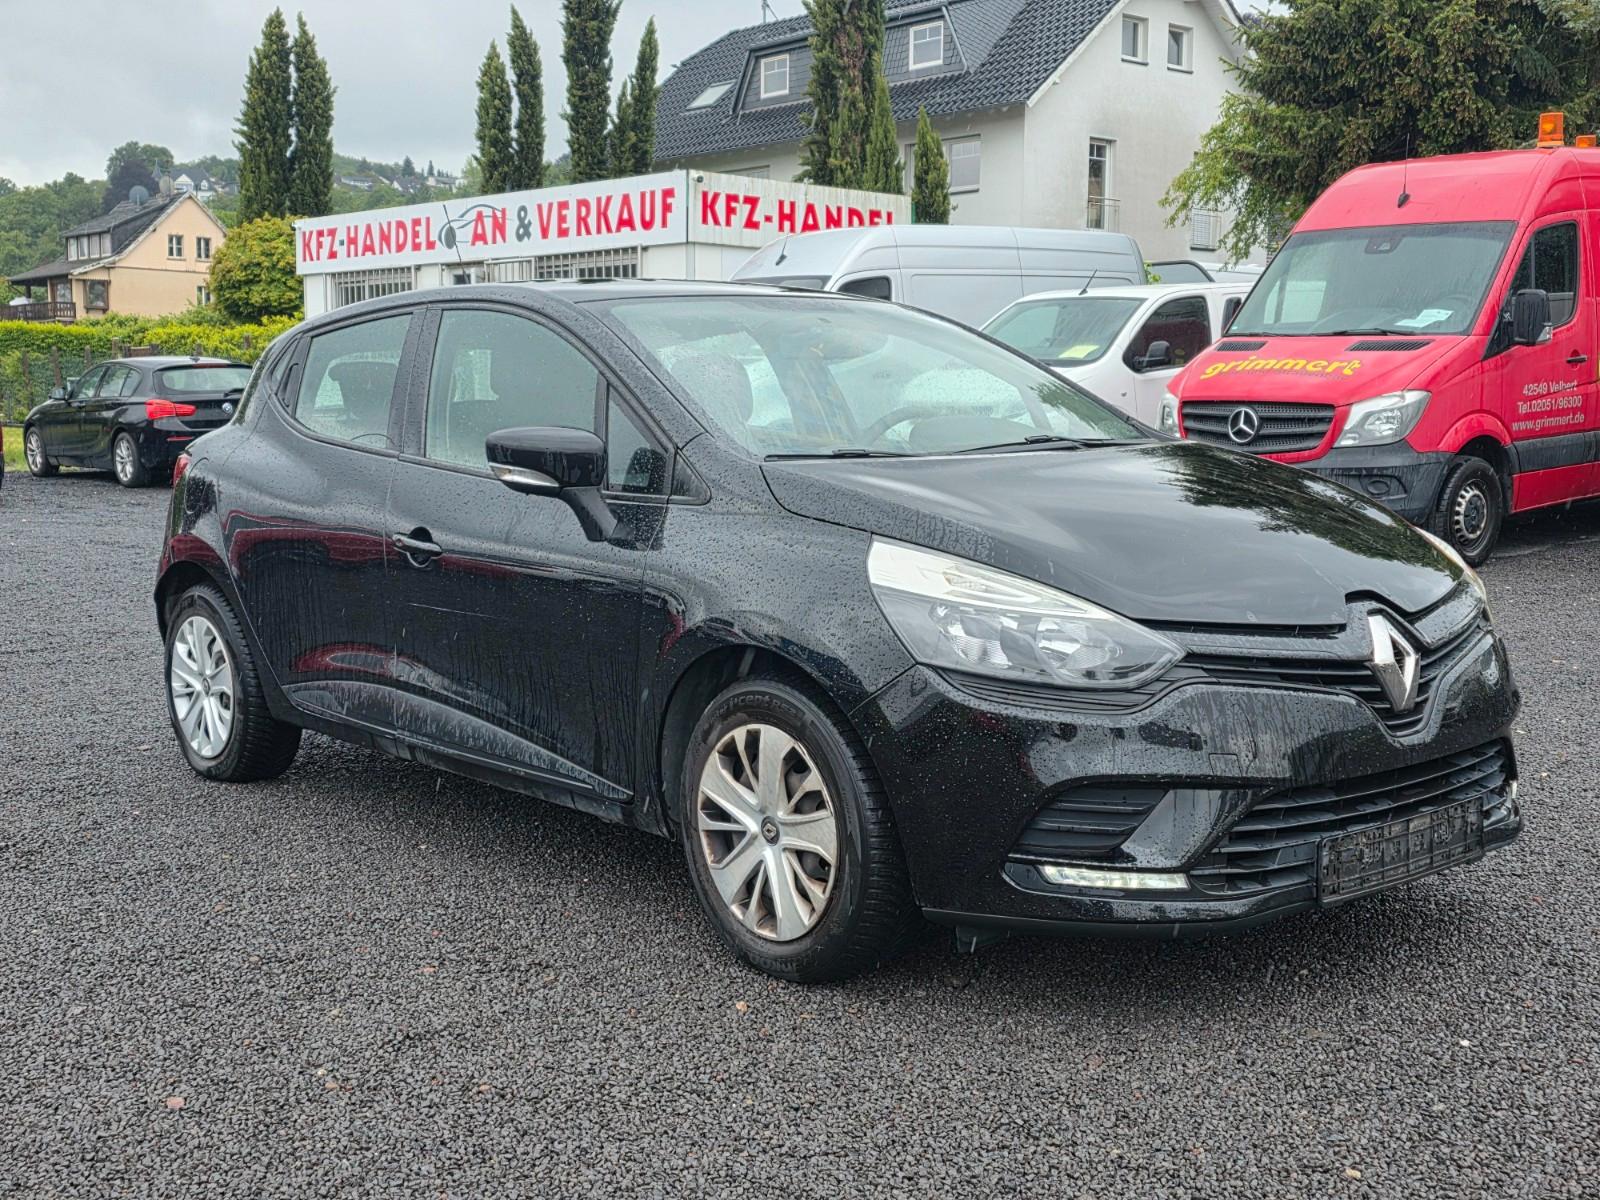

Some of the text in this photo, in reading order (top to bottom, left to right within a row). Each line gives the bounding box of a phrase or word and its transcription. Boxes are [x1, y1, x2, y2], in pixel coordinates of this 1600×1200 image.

[302, 187, 676, 262] KFZ-HANDEL AN & VERKAUF
[1200, 356, 1361, 380] grimmert
[1523, 382, 1548, 396] 42549
[1512, 412, 1585, 431] www.grimmert.de
